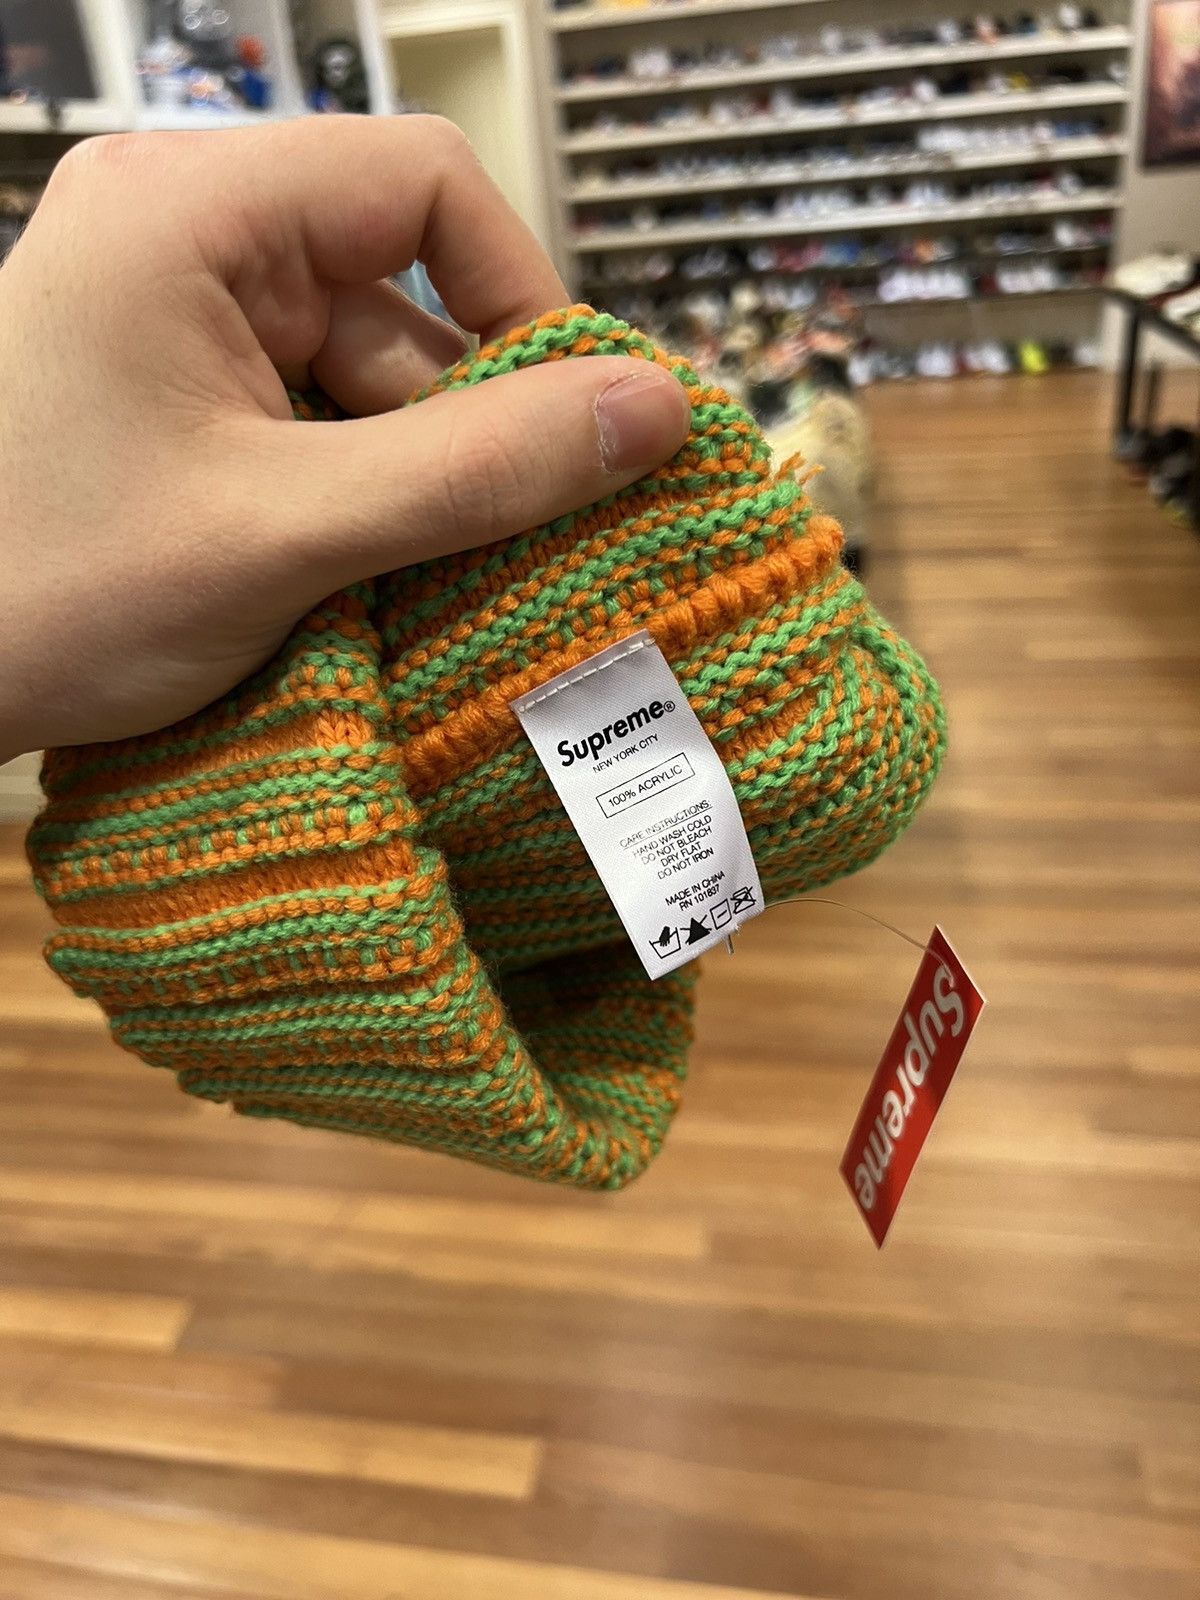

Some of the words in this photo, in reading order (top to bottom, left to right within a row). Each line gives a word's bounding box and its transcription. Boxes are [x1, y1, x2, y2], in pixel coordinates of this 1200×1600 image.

[592, 758, 613, 773] NEW
[613, 744, 639, 761] YORK
[639, 733, 658, 749] CITY
[608, 789, 636, 807] 100%
[638, 764, 682, 793] ACRYLIC
[620, 831, 645, 848] CARE
[633, 840, 659, 858] HAND
[658, 827, 686, 845] WASH
[687, 815, 712, 832] COLD
[641, 852, 656, 865] DO
[656, 843, 676, 857] NOT
[676, 826, 712, 848] BLEACH
[660, 852, 679, 867] DRY
[680, 841, 702, 857] FLAT
[657, 867, 672, 880] DO
[672, 857, 691, 873] NOT
[692, 847, 714, 863] IRON
[665, 887, 692, 906] MADE
[691, 883, 701, 893] IN
[701, 870, 725, 889] CHINA
[679, 898, 693, 911] RN
[694, 883, 720, 904] 101837
[854, 964, 964, 1212] Supreme
